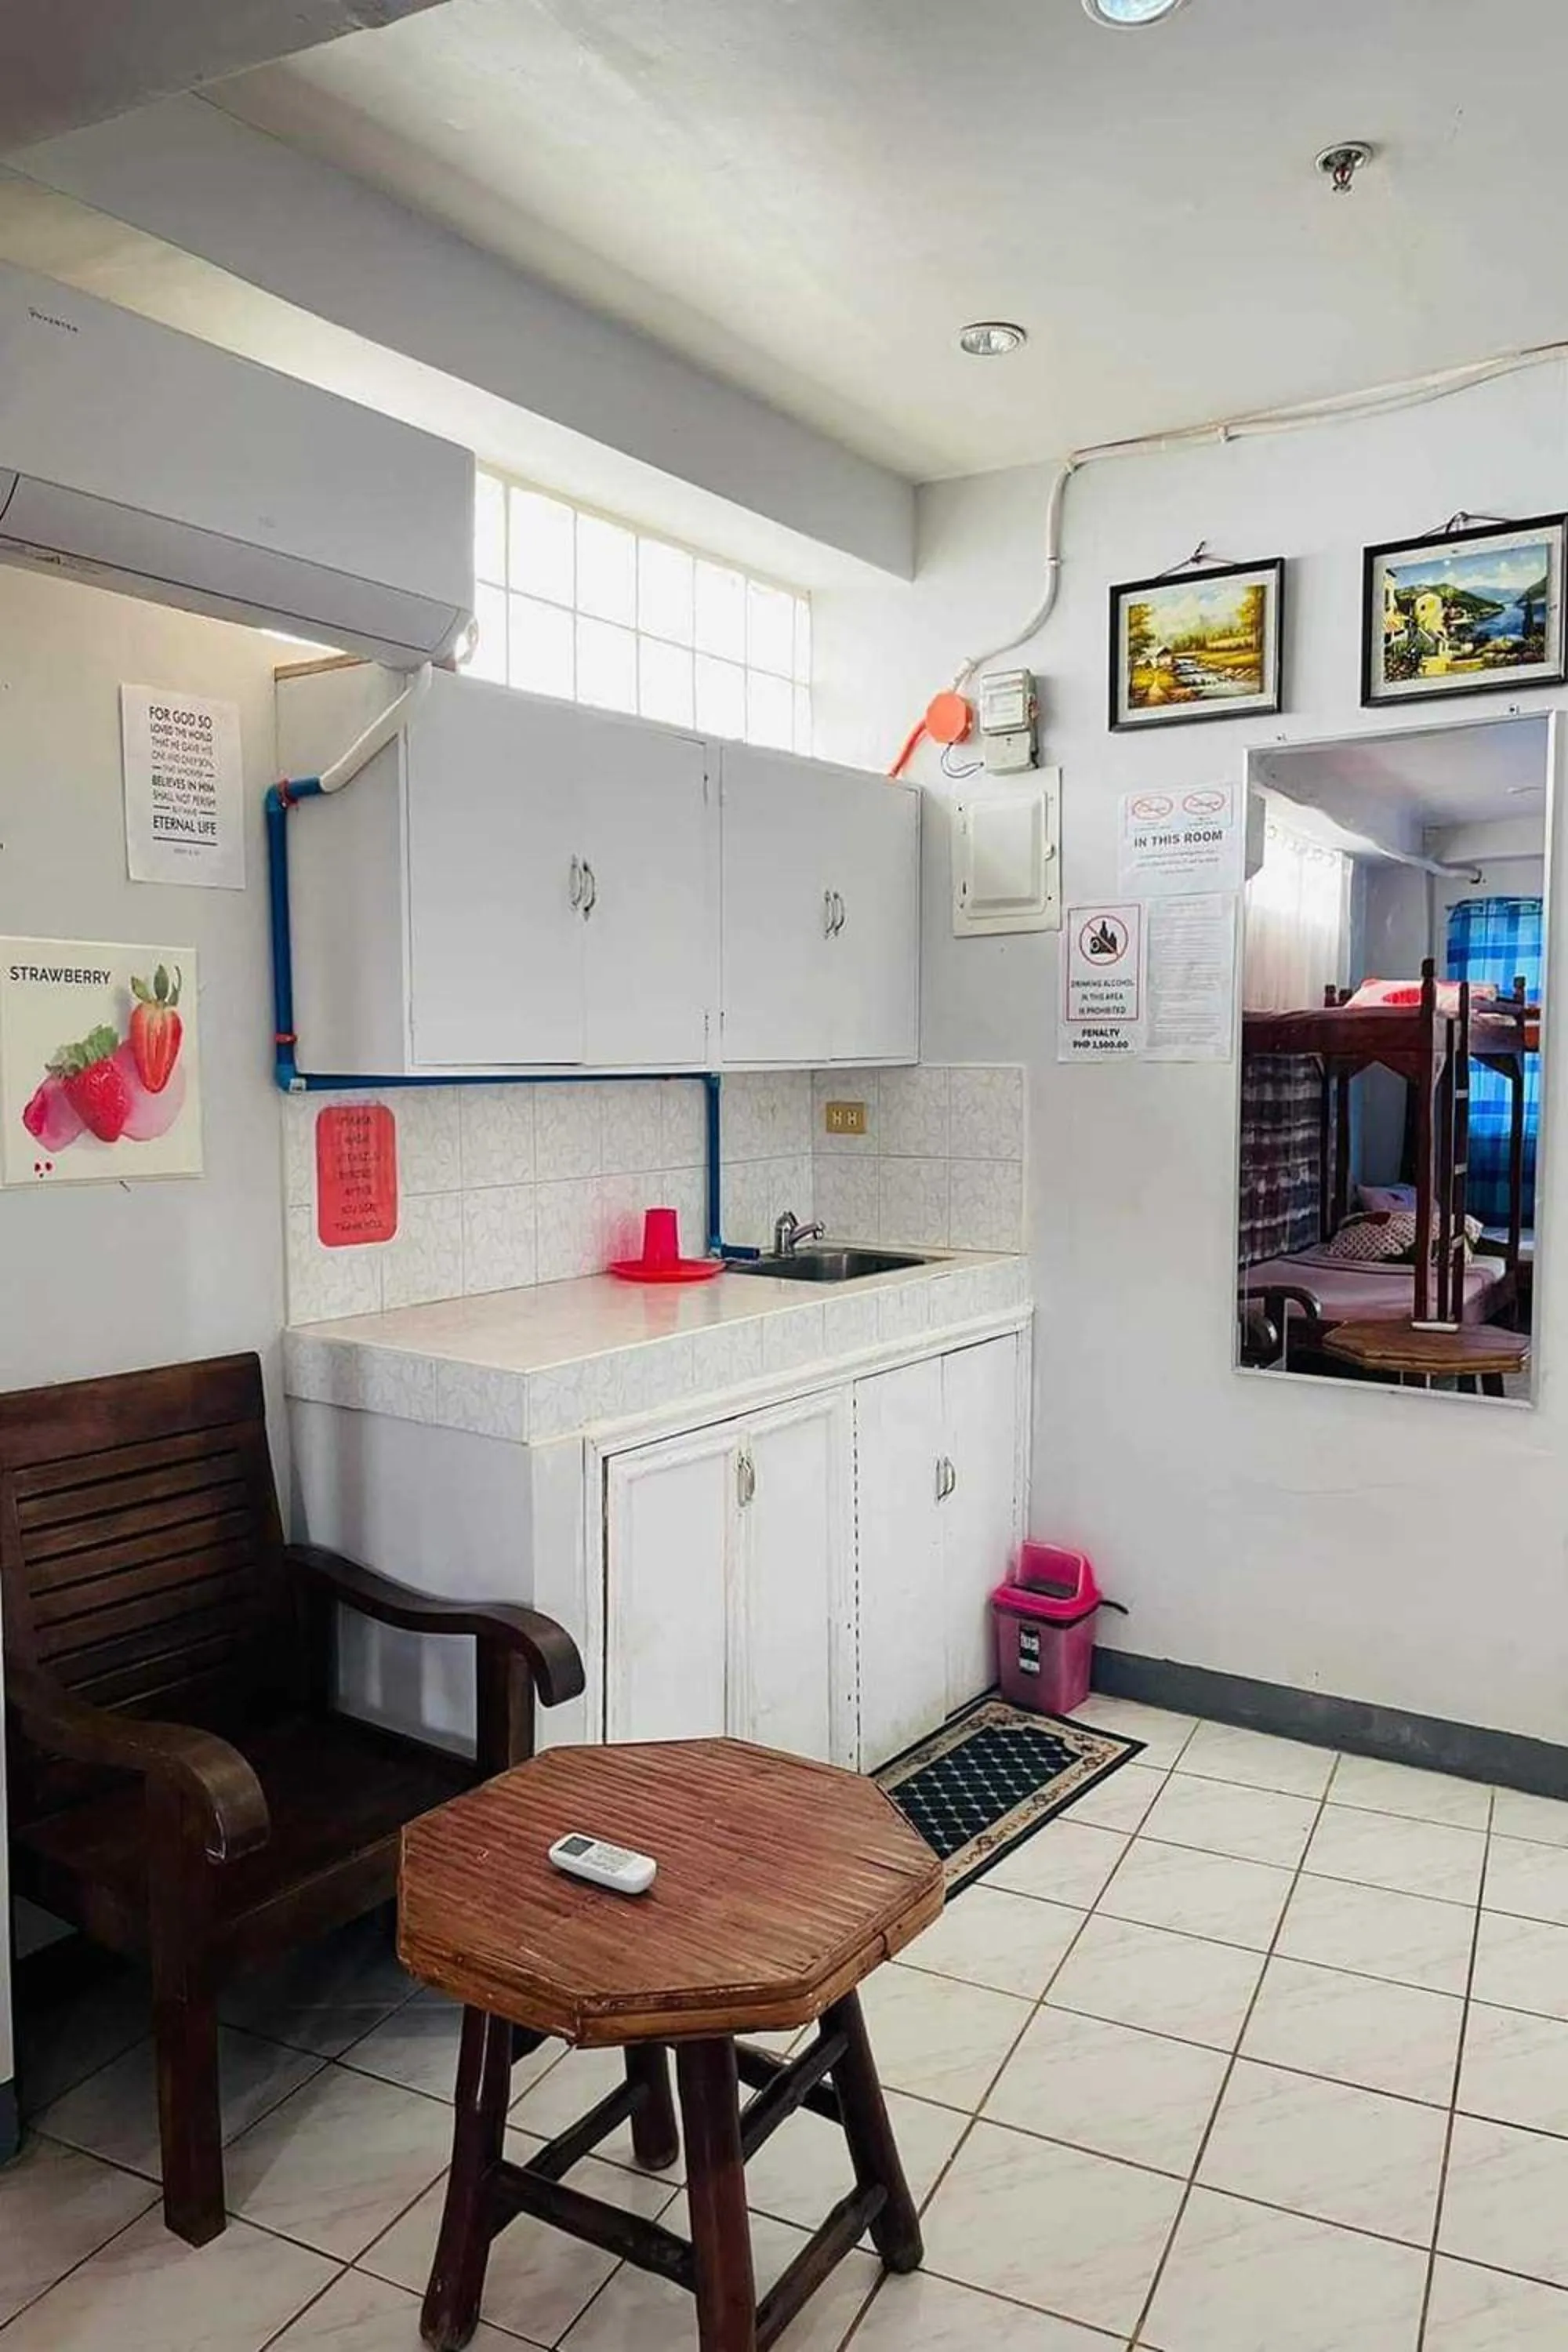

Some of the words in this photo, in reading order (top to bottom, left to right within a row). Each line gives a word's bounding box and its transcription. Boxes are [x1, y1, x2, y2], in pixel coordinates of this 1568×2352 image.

[150, 706, 171, 721] FOR
[172, 710, 196, 727] GOD
[198, 714, 212, 730] SO
[152, 775, 186, 789] BELIEVES
[188, 781, 197, 791] IN
[153, 815, 195, 833] ETERNAL
[198, 821, 217, 836] LIFE
[1134, 837, 1147, 848] IN
[1152, 833, 1180, 846] THIS
[1184, 830, 1223, 844] ROOM
[9, 966, 111, 985] STRAWBERRY
[1082, 1028, 1120, 1037] PENALTY
